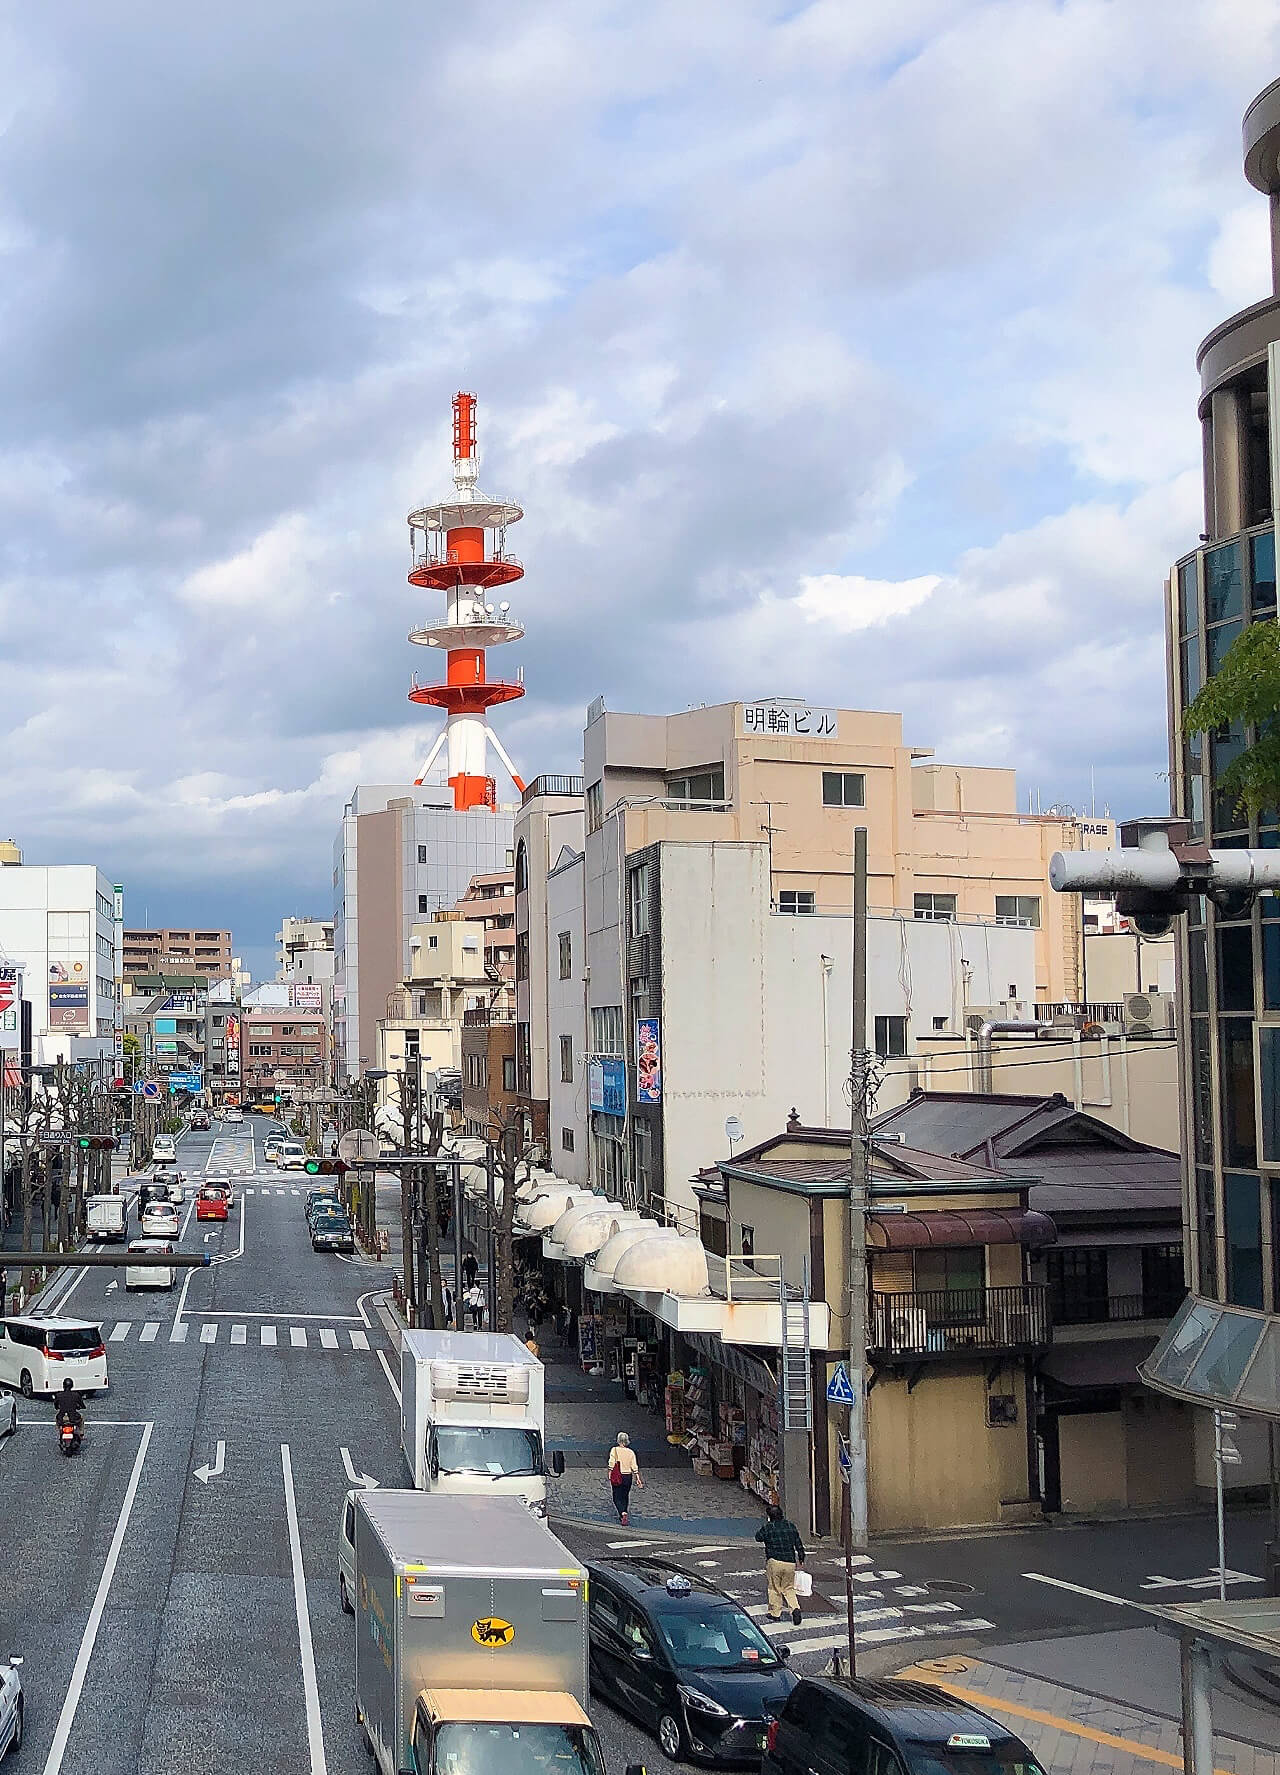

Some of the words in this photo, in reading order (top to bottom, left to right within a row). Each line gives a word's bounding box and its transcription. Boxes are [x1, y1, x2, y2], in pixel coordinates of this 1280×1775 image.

[745, 706, 836, 736] 明輪ビル
[228, 1049, 239, 1074] 焼肉
